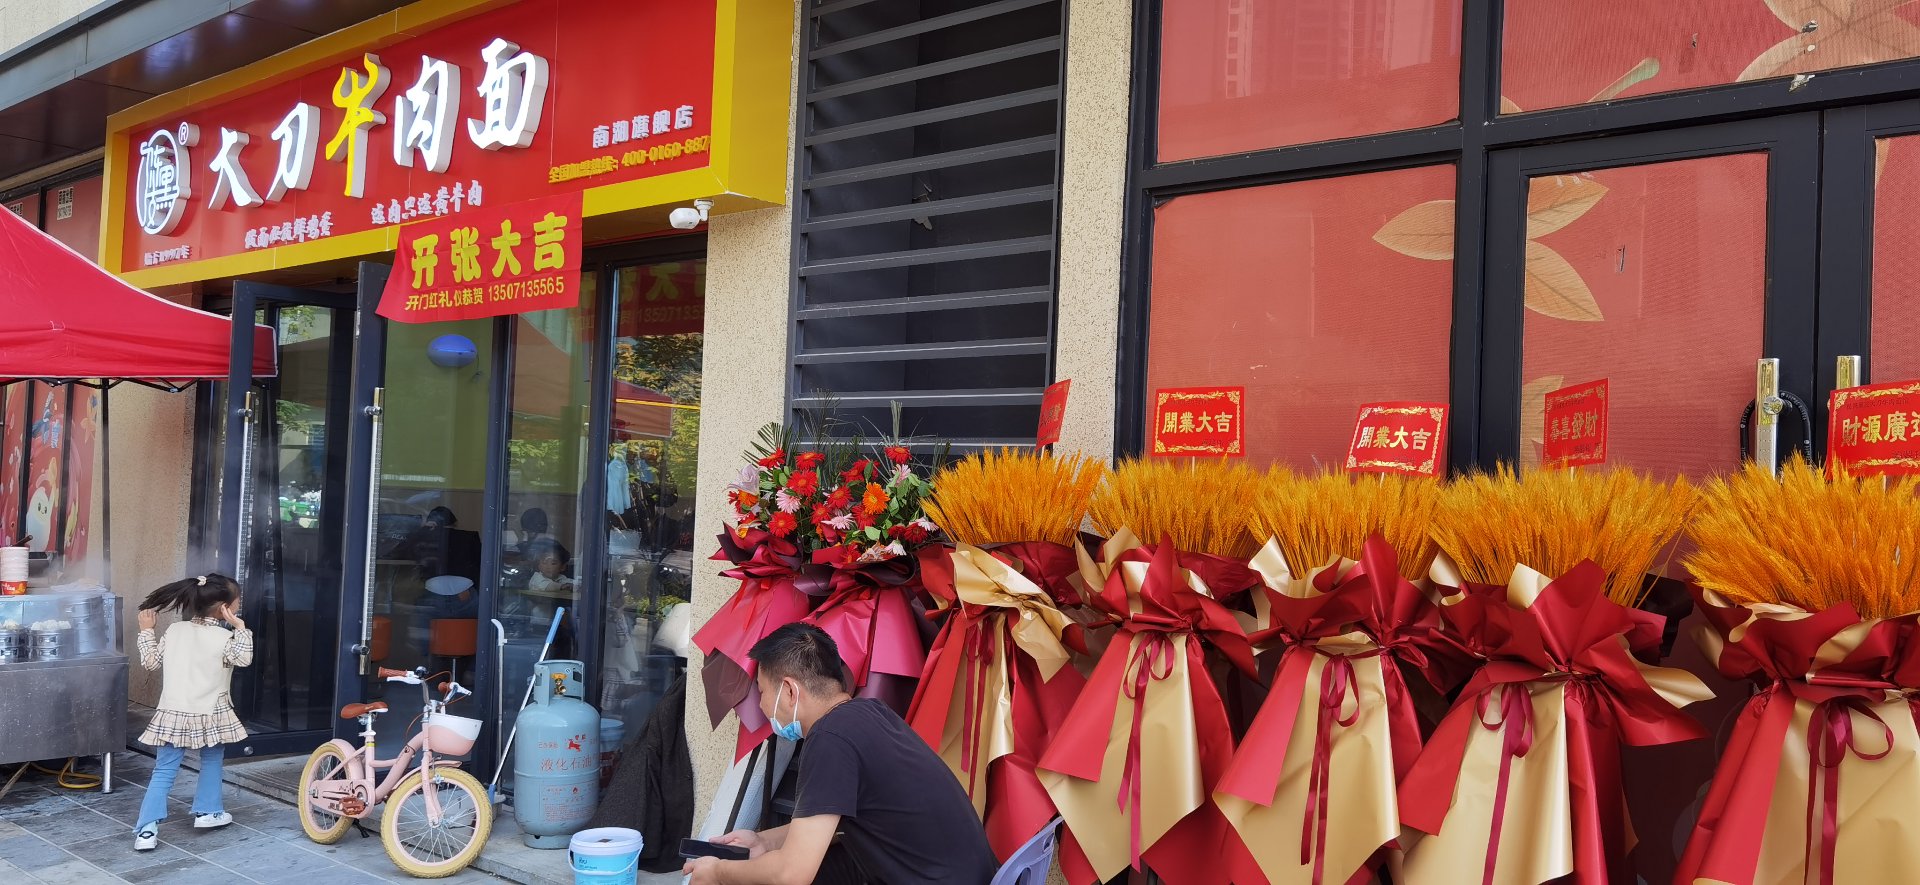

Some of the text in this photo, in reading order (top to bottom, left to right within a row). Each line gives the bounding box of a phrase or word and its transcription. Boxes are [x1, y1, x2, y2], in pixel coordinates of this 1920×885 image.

[208, 38, 548, 210] 大刀牛肉面
[592, 105, 694, 148] 南湖旗舰店
[371, 180, 482, 224] 选肉只选黄牛肉
[411, 212, 568, 289] 开张大吉
[405, 287, 483, 311] 开门红礼仪恭贺
[488, 276, 564, 302] 13507135565
[1162, 411, 1233, 434] 開業大吉
[1357, 425, 1432, 450] 開業大吉
[1550, 407, 1599, 442] 恭喜發財
[541, 754, 597, 771] 液化石油
